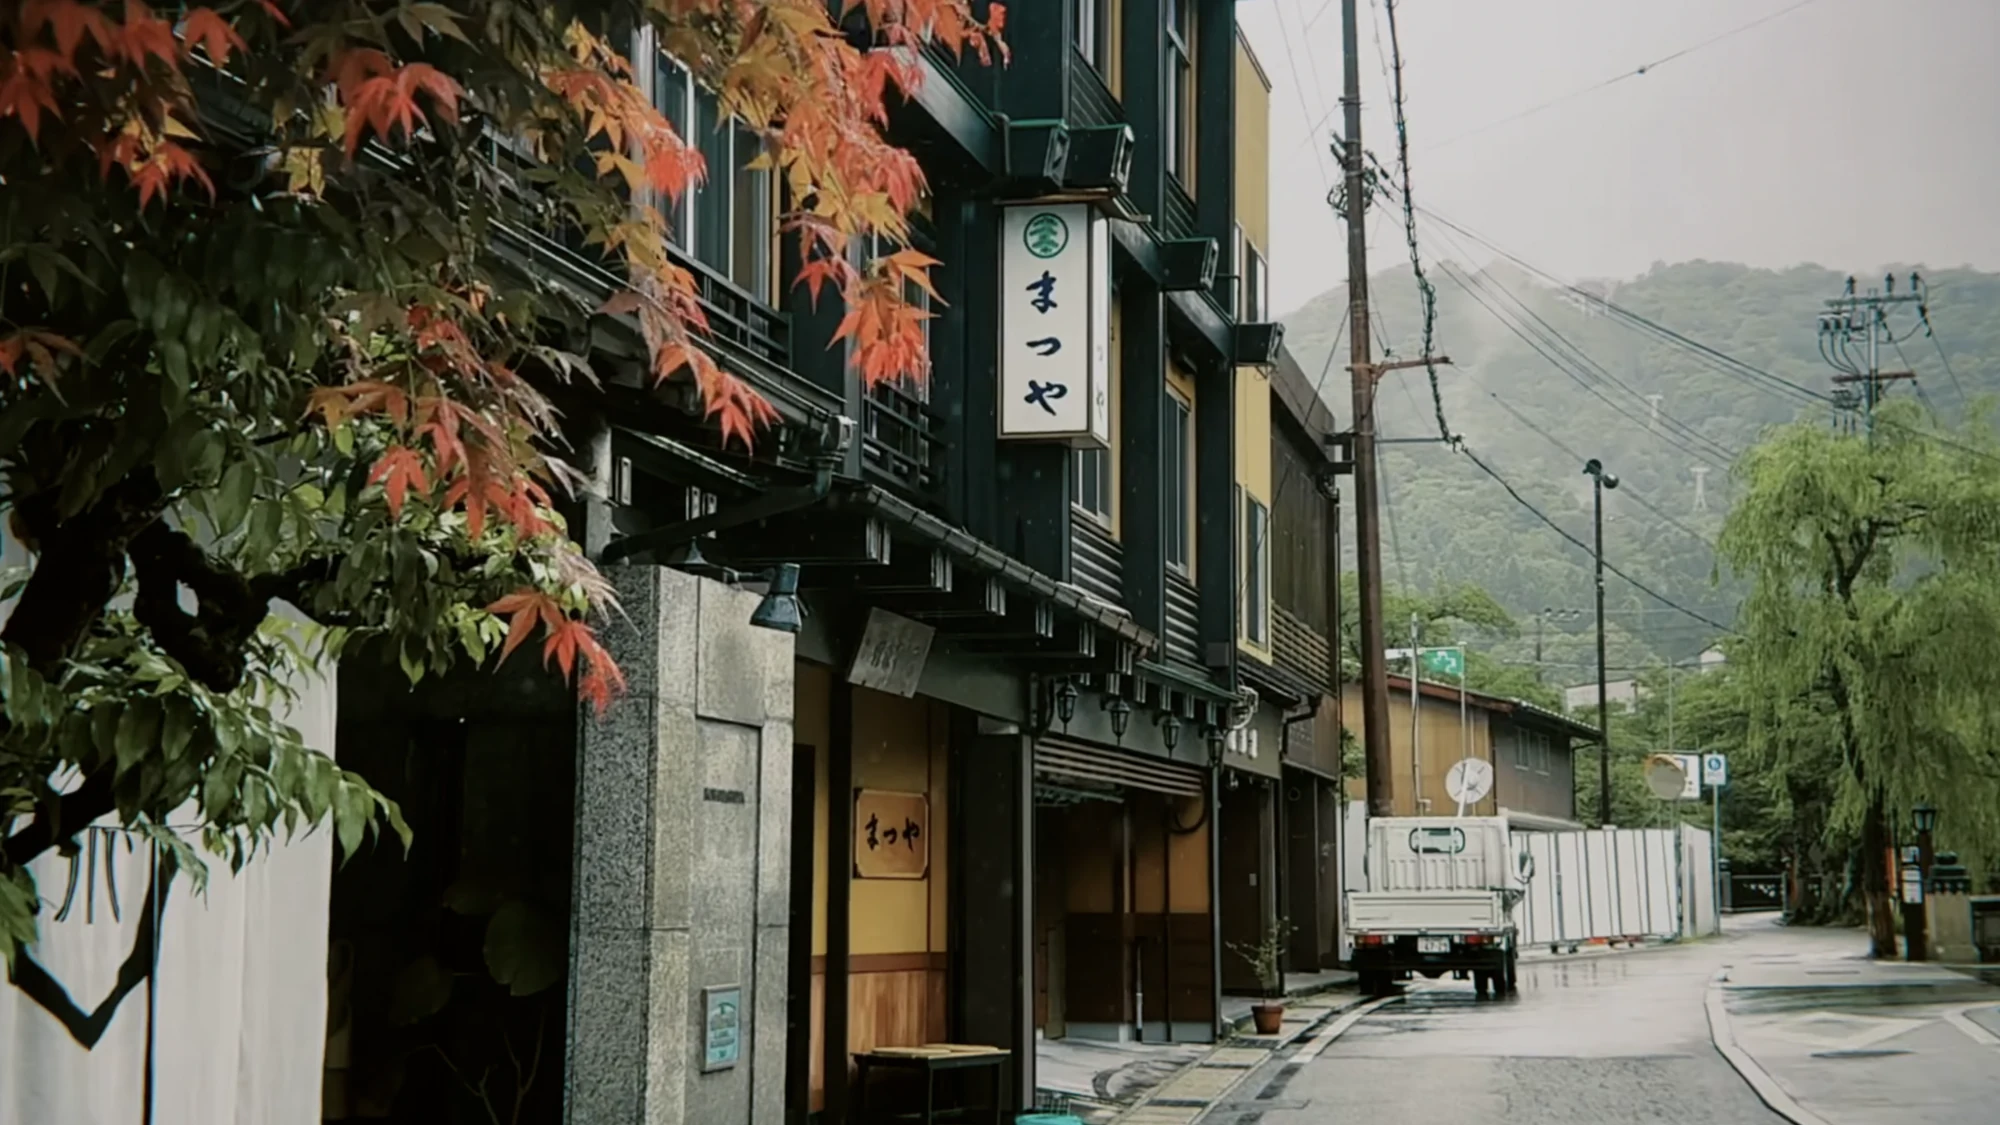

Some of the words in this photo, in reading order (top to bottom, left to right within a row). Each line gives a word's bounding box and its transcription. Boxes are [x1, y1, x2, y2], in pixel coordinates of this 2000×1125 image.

[1024, 269, 1067, 416] まつや
[865, 812, 920, 853] まつや
